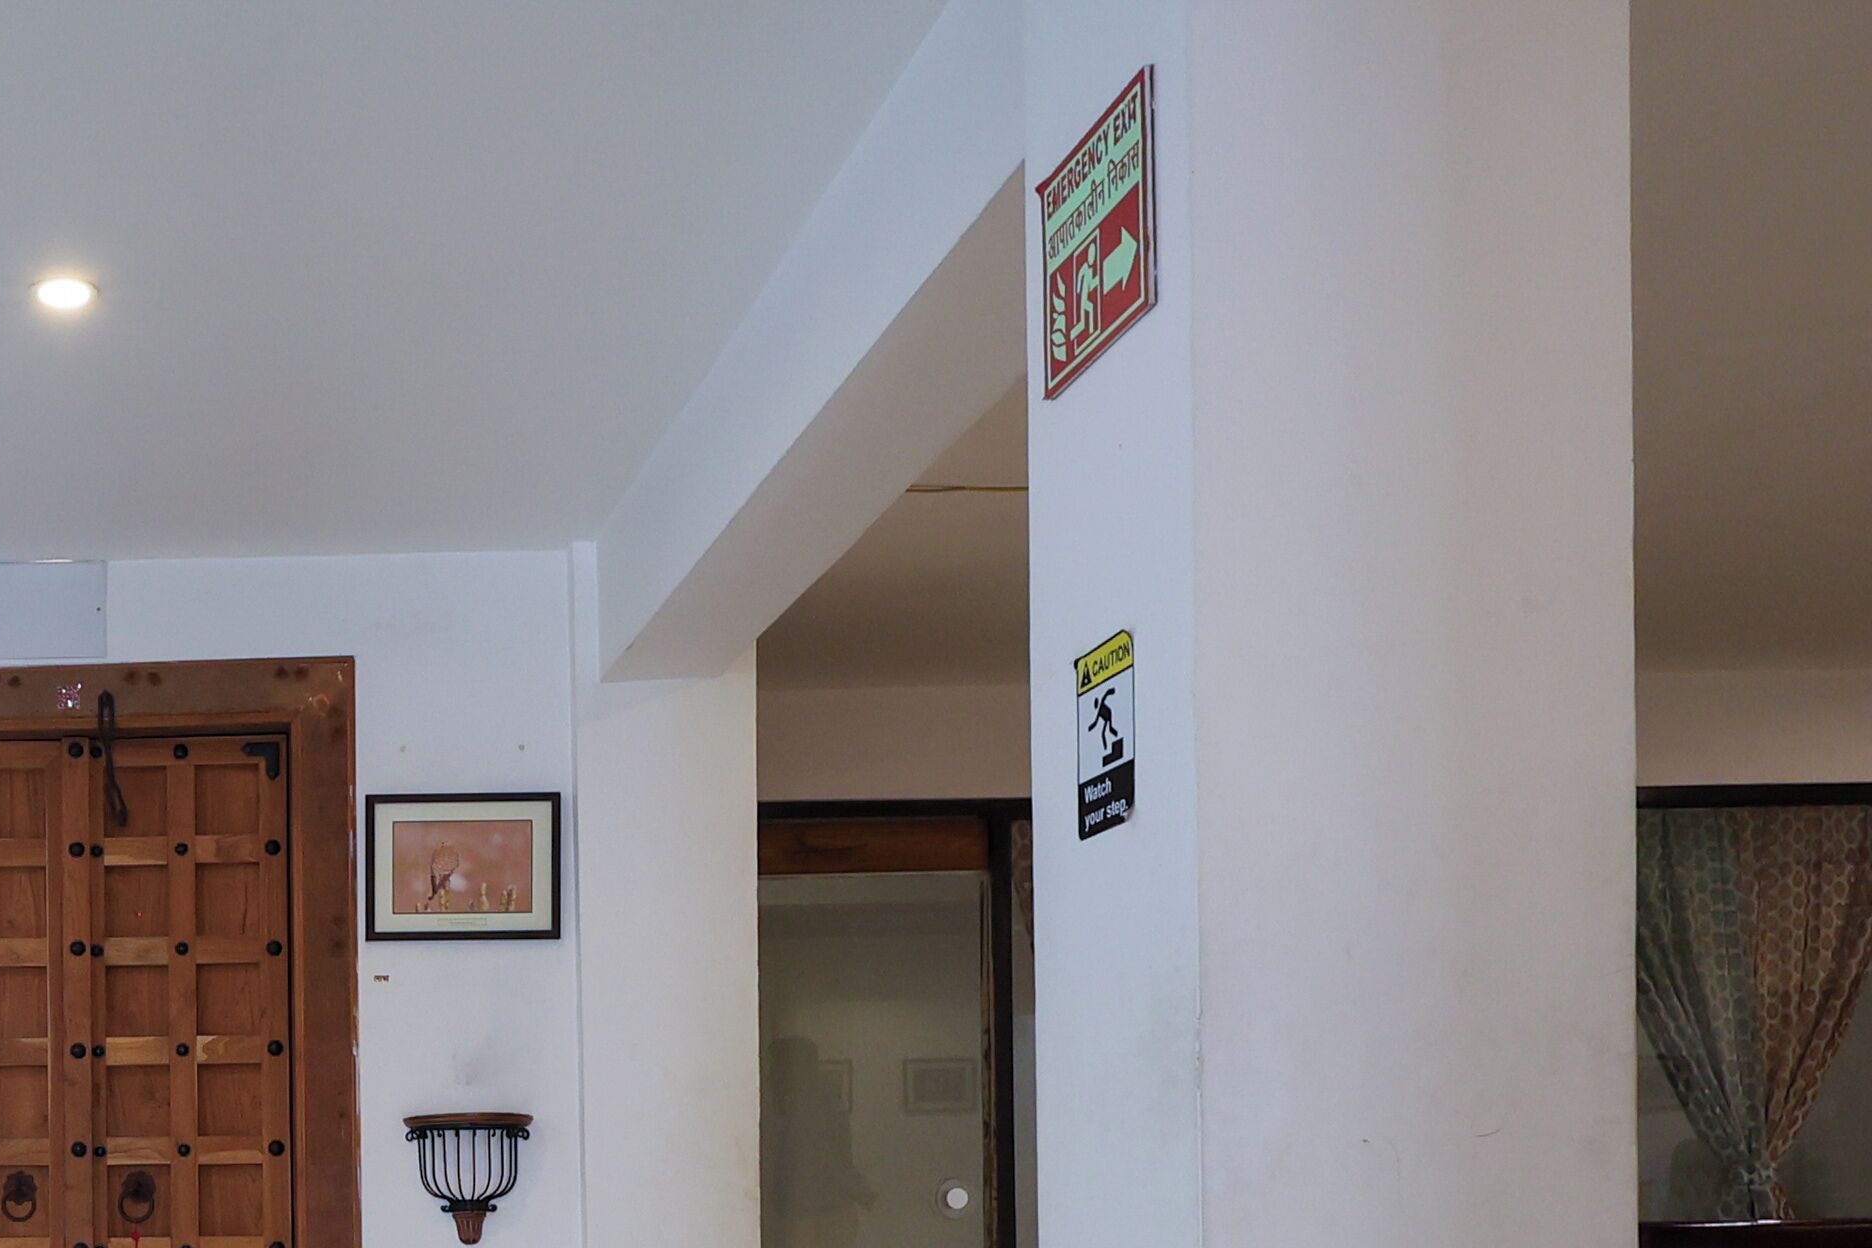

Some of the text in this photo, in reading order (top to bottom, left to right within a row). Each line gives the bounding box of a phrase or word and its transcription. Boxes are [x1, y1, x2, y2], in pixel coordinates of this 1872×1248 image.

[1046, 91, 1139, 221] EMERGENCY EXIT
[1048, 139, 1140, 260] आपातकालीन निकास
[1092, 640, 1131, 678] CAUTION
[1084, 776, 1112, 804] Watch
[1084, 807, 1105, 832] your
